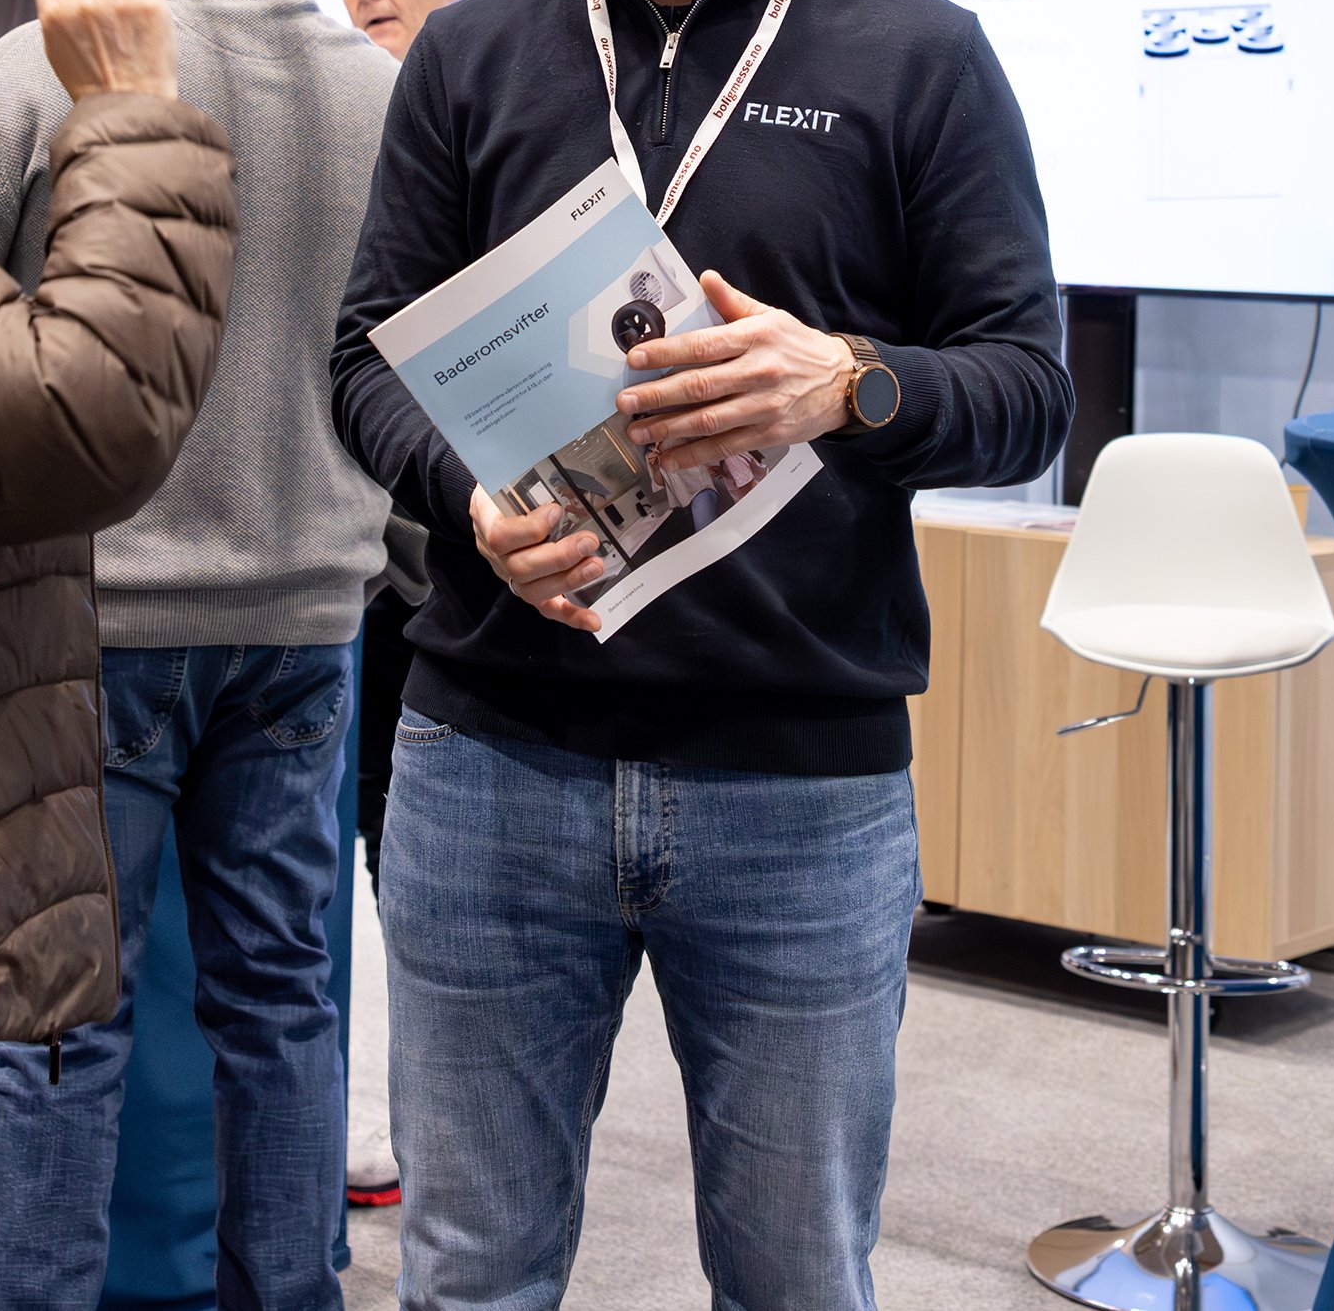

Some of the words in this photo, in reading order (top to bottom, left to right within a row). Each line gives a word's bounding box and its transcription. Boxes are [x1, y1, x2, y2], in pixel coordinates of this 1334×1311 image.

[713, 43, 763, 120] boligmesse.no
[743, 102, 841, 133] FLEXIT
[570, 186, 606, 221] FLEXIT
[433, 302, 550, 386] Baderomsvifter
